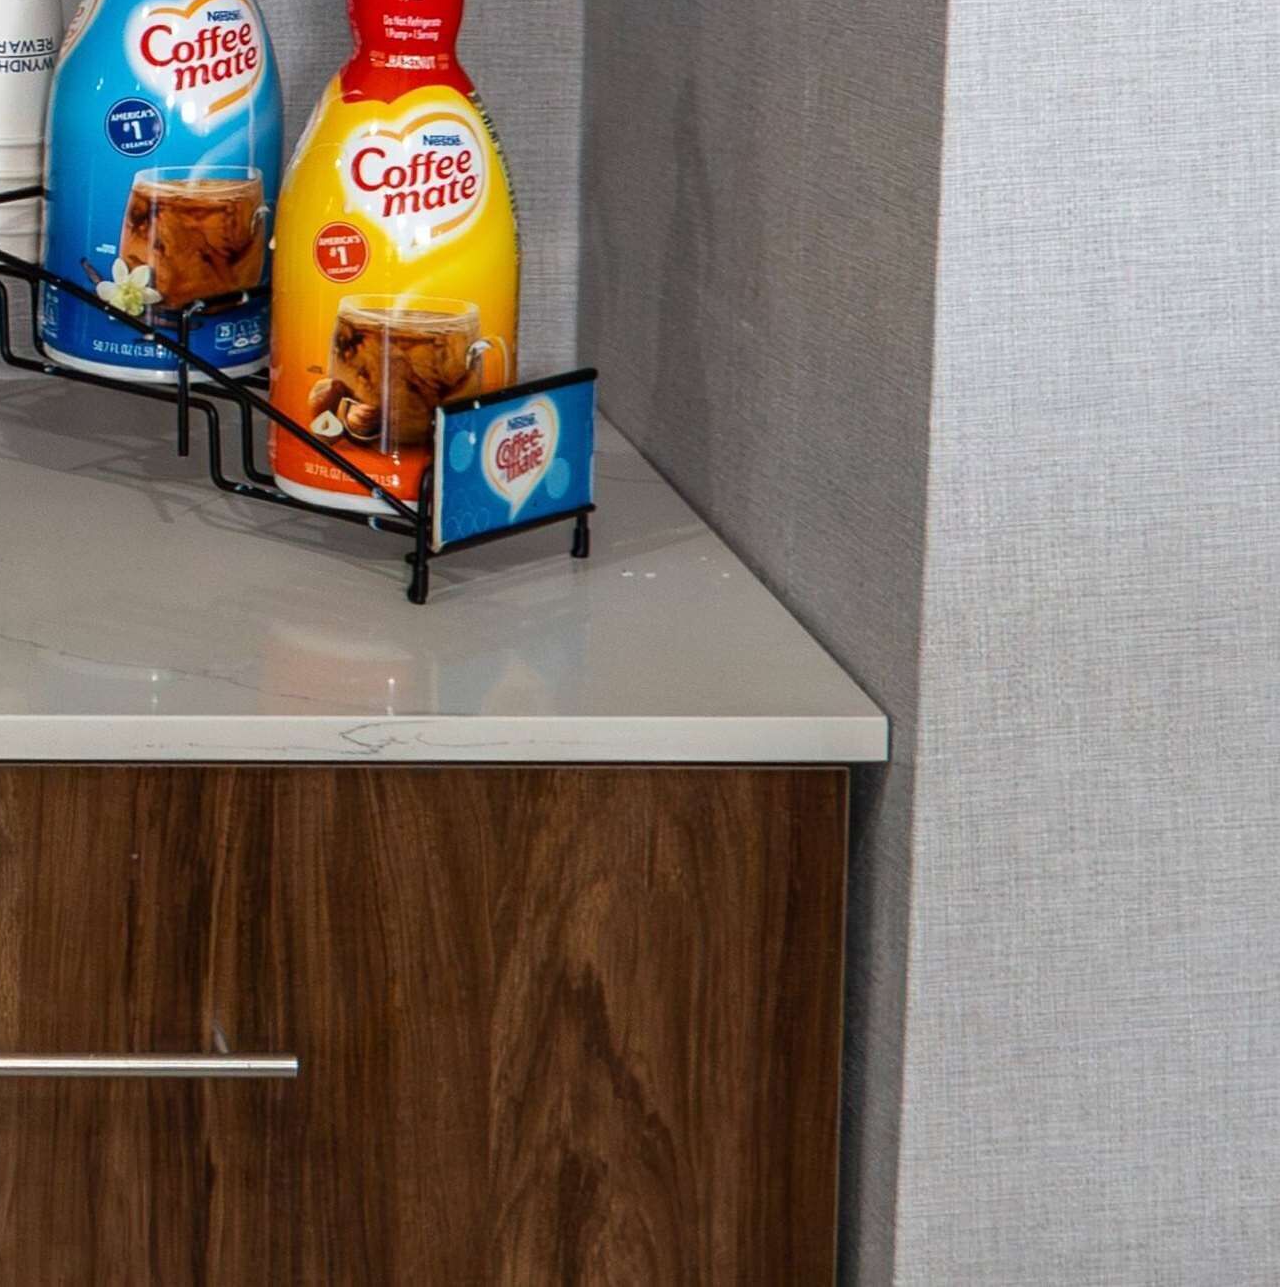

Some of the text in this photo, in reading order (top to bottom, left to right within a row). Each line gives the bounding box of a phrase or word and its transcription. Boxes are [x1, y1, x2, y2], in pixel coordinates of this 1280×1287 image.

[140, 23, 252, 66] Coffee
[174, 45, 258, 91] mate
[351, 149, 472, 192] Coffee
[382, 175, 477, 217] mate
